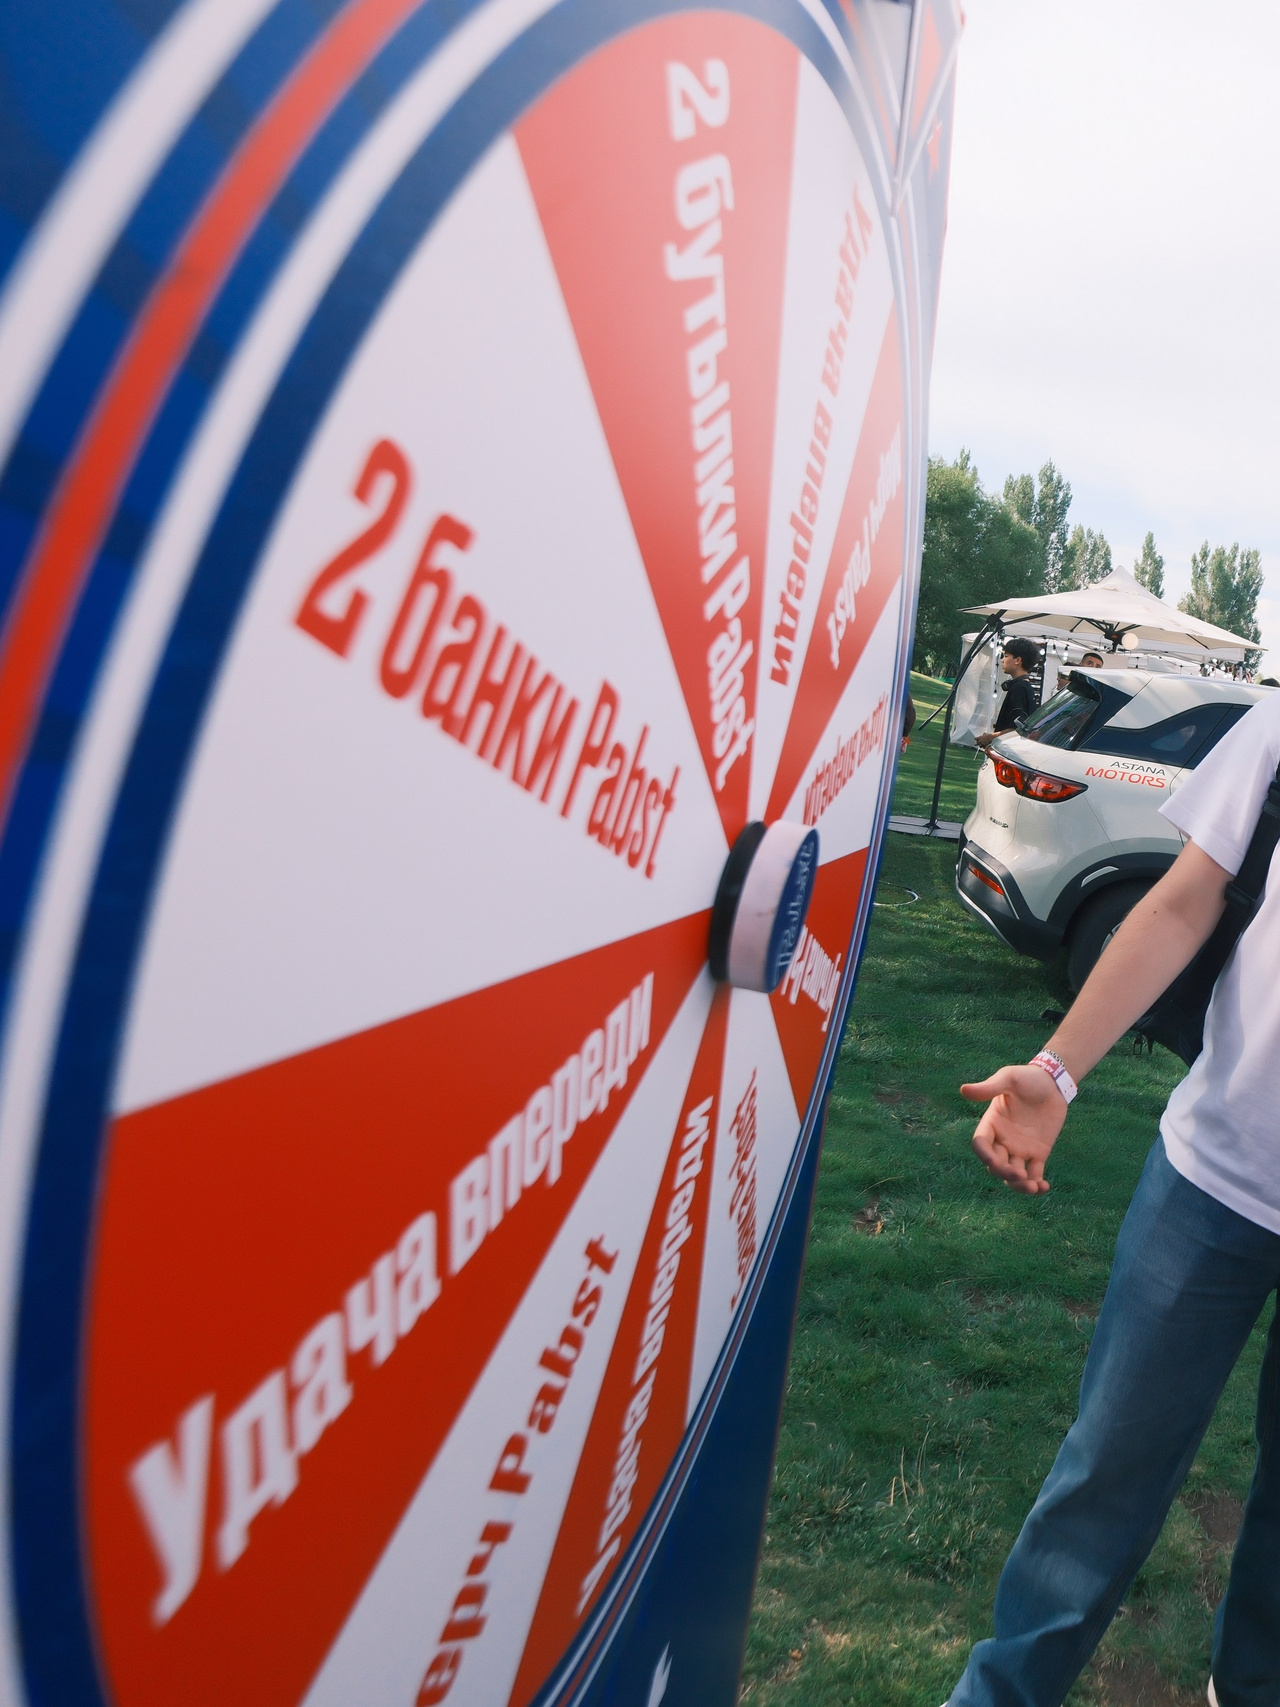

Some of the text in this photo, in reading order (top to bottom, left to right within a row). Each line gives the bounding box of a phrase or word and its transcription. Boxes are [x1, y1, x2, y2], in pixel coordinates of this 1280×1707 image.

[664, 58, 756, 791] 2 бутылки Pabst
[770, 181, 873, 687] Удача впереди
[826, 515, 872, 670] Pabst
[293, 436, 682, 880] 2 банки Pabst
[1085, 766, 1167, 789] MOTORS
[1110, 761, 1166, 776] ASTANA
[126, 971, 655, 1629] Удача впереди
[631, 1094, 714, 1387] впереди
[414, 1233, 621, 1707] ерч Pabst
